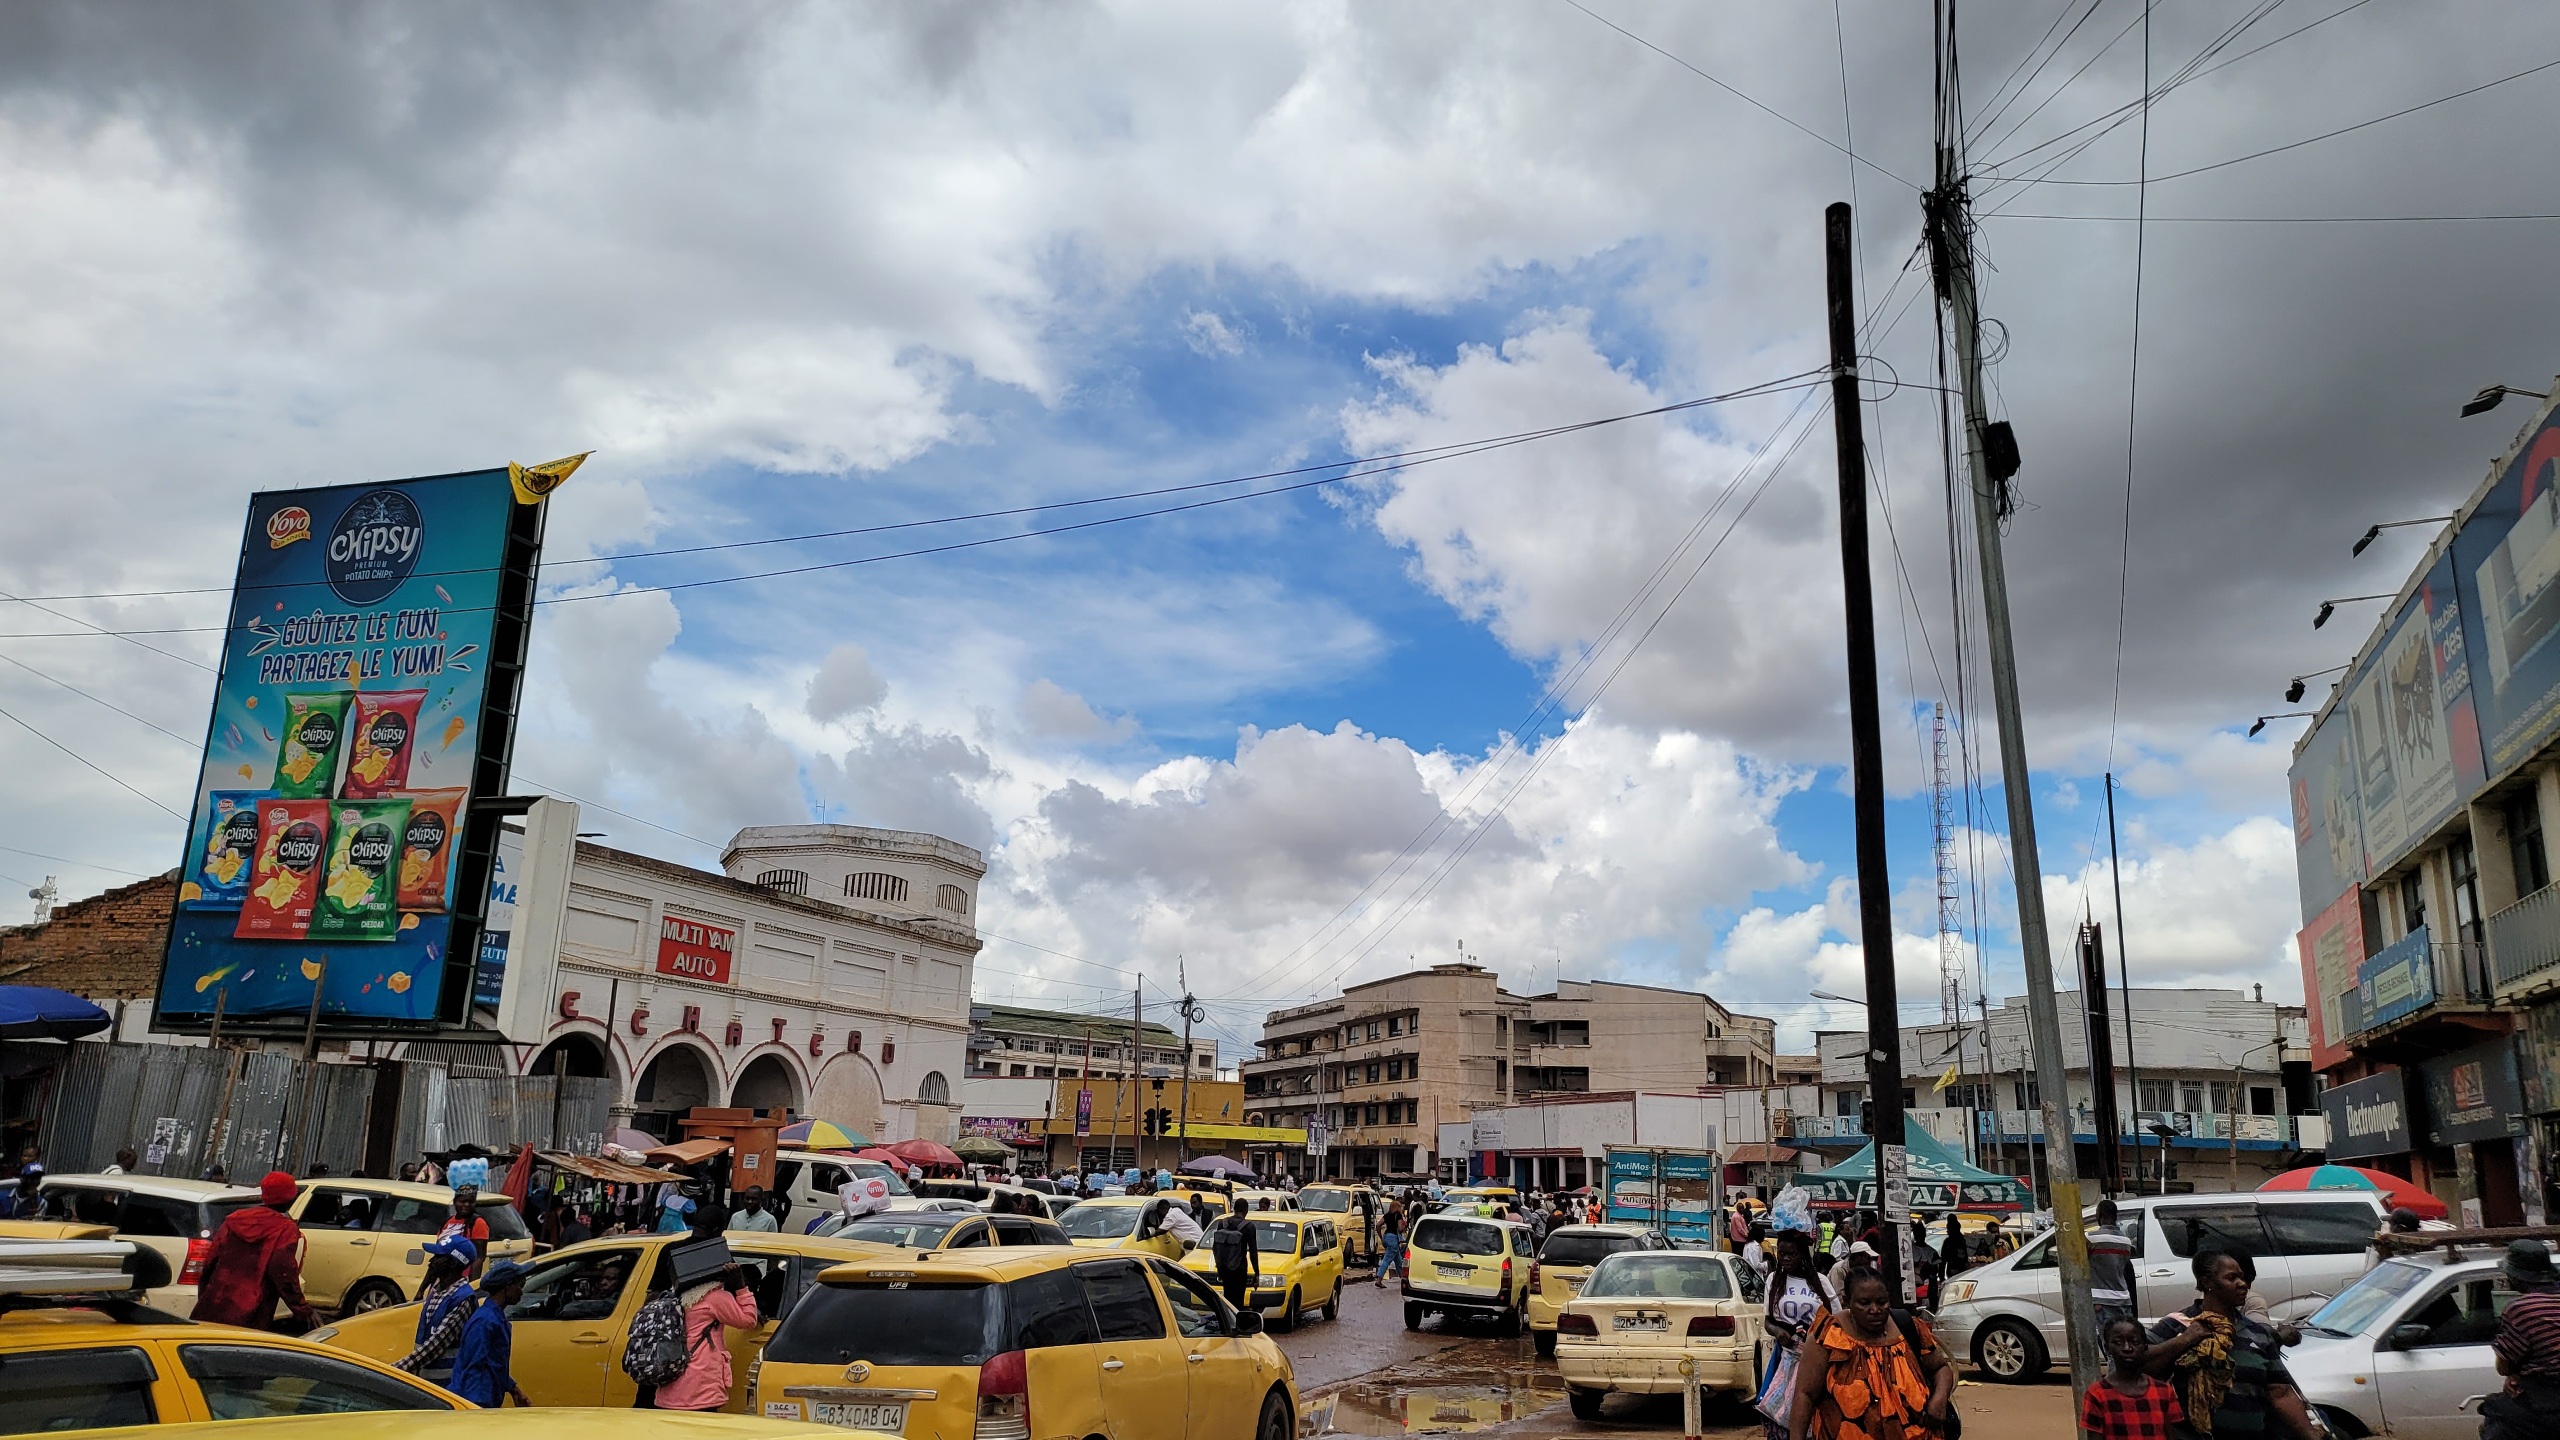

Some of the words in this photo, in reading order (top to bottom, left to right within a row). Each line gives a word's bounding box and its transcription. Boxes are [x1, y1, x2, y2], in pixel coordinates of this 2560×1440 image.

[270, 509, 309, 536] Yoyo
[345, 570, 371, 583] POTATO
[371, 570, 394, 580] CHIPS
[354, 561, 387, 570] PREMIUM
[281, 608, 359, 648] GOÛTEZ
[364, 612, 389, 642] LE
[394, 607, 439, 640] FUN
[2443, 625, 2462, 662] des
[258, 650, 354, 684] PARTAGEZ
[359, 649, 383, 679] LE
[391, 644, 446, 678] YUM!
[2442, 661, 2468, 705] rêves
[294, 909, 312, 917] SWEET
[361, 920, 384, 929] CHEDDAR
[662, 919, 704, 946] MULTI
[707, 929, 735, 952] YAM
[672, 952, 717, 977] AUTO
[2345, 1092, 2400, 1142] Électronique
[1864, 1186, 1948, 1205] TTAL
[882, 1408, 899, 1427] 04
